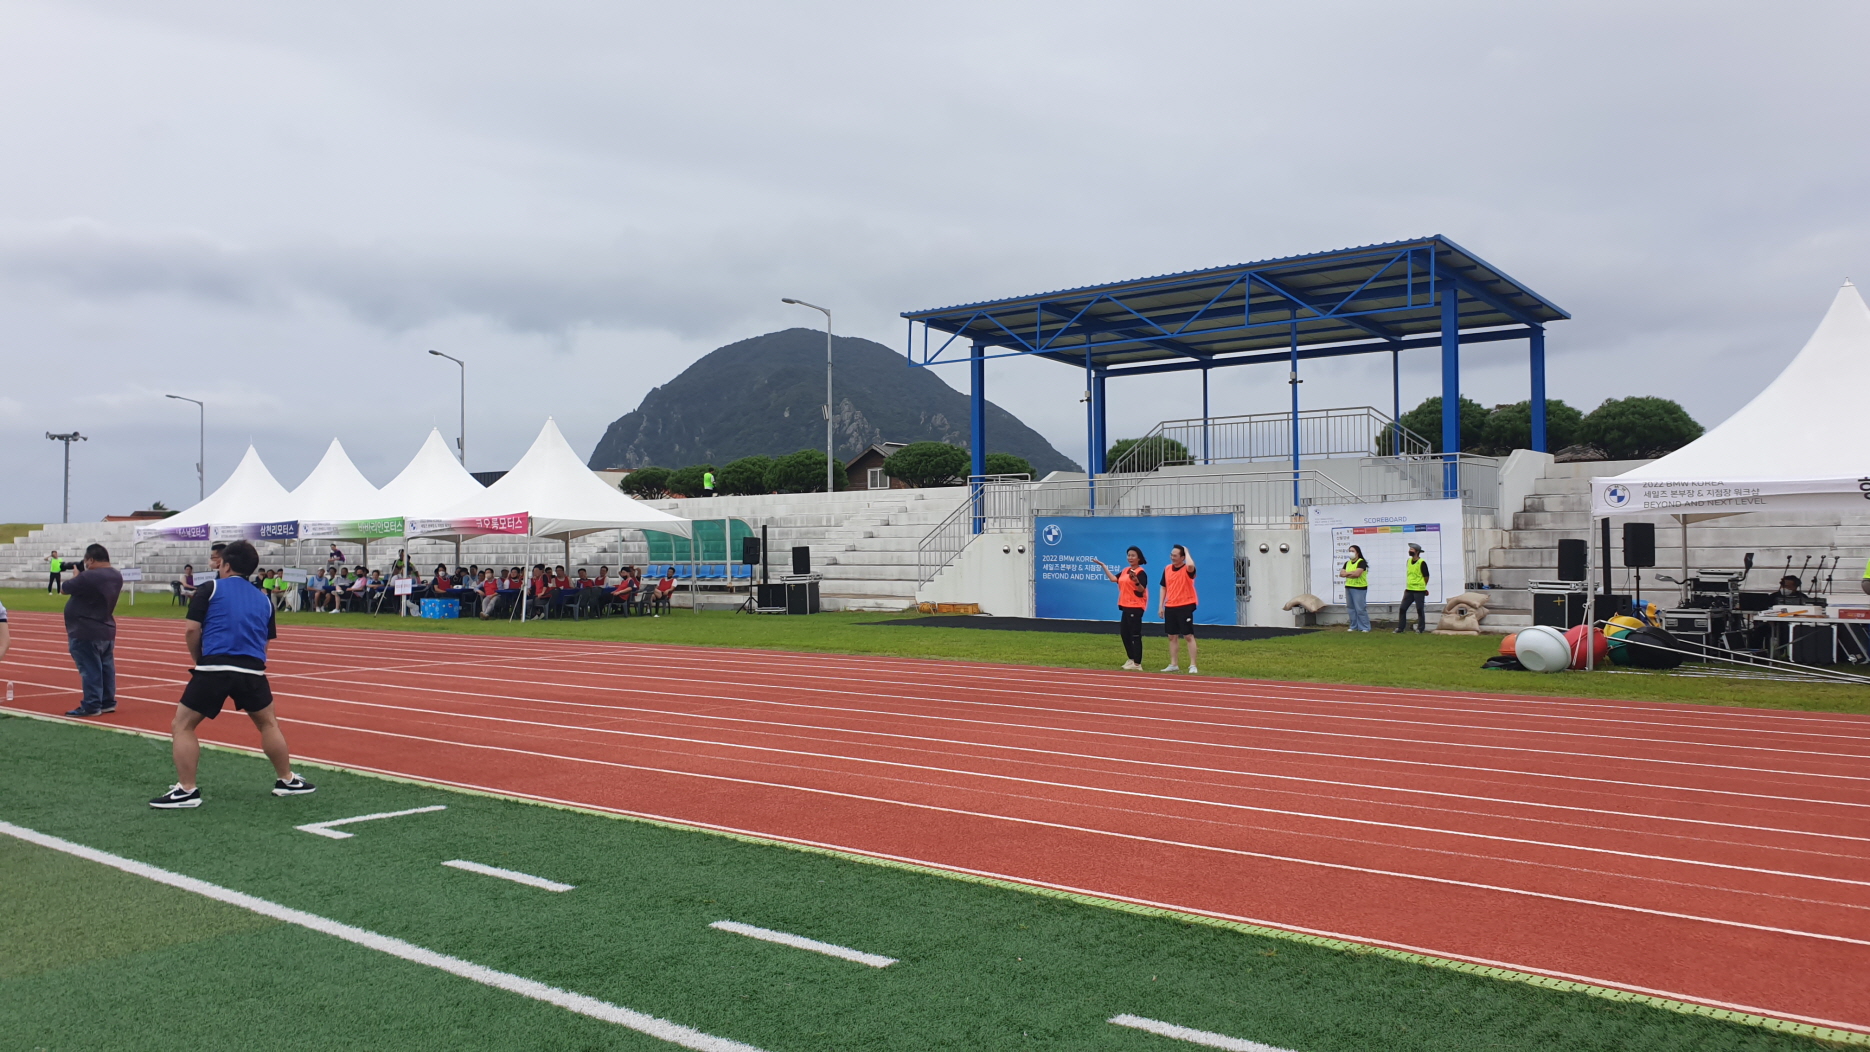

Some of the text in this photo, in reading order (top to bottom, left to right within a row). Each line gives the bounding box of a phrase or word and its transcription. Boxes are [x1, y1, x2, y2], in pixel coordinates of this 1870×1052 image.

[1643, 490, 1668, 498] 세일즈
[1670, 489, 1695, 498] 본부장
[1706, 489, 1731, 497] 지점장
[1643, 500, 1683, 509] BEYOND
[1684, 499, 1705, 507] AND
[1707, 498, 1733, 506] NEXT
[1363, 516, 1407, 524] SCOREBOARD
[260, 524, 295, 537] 삼천리모터스
[1085, 573, 1103, 581] NEXT
